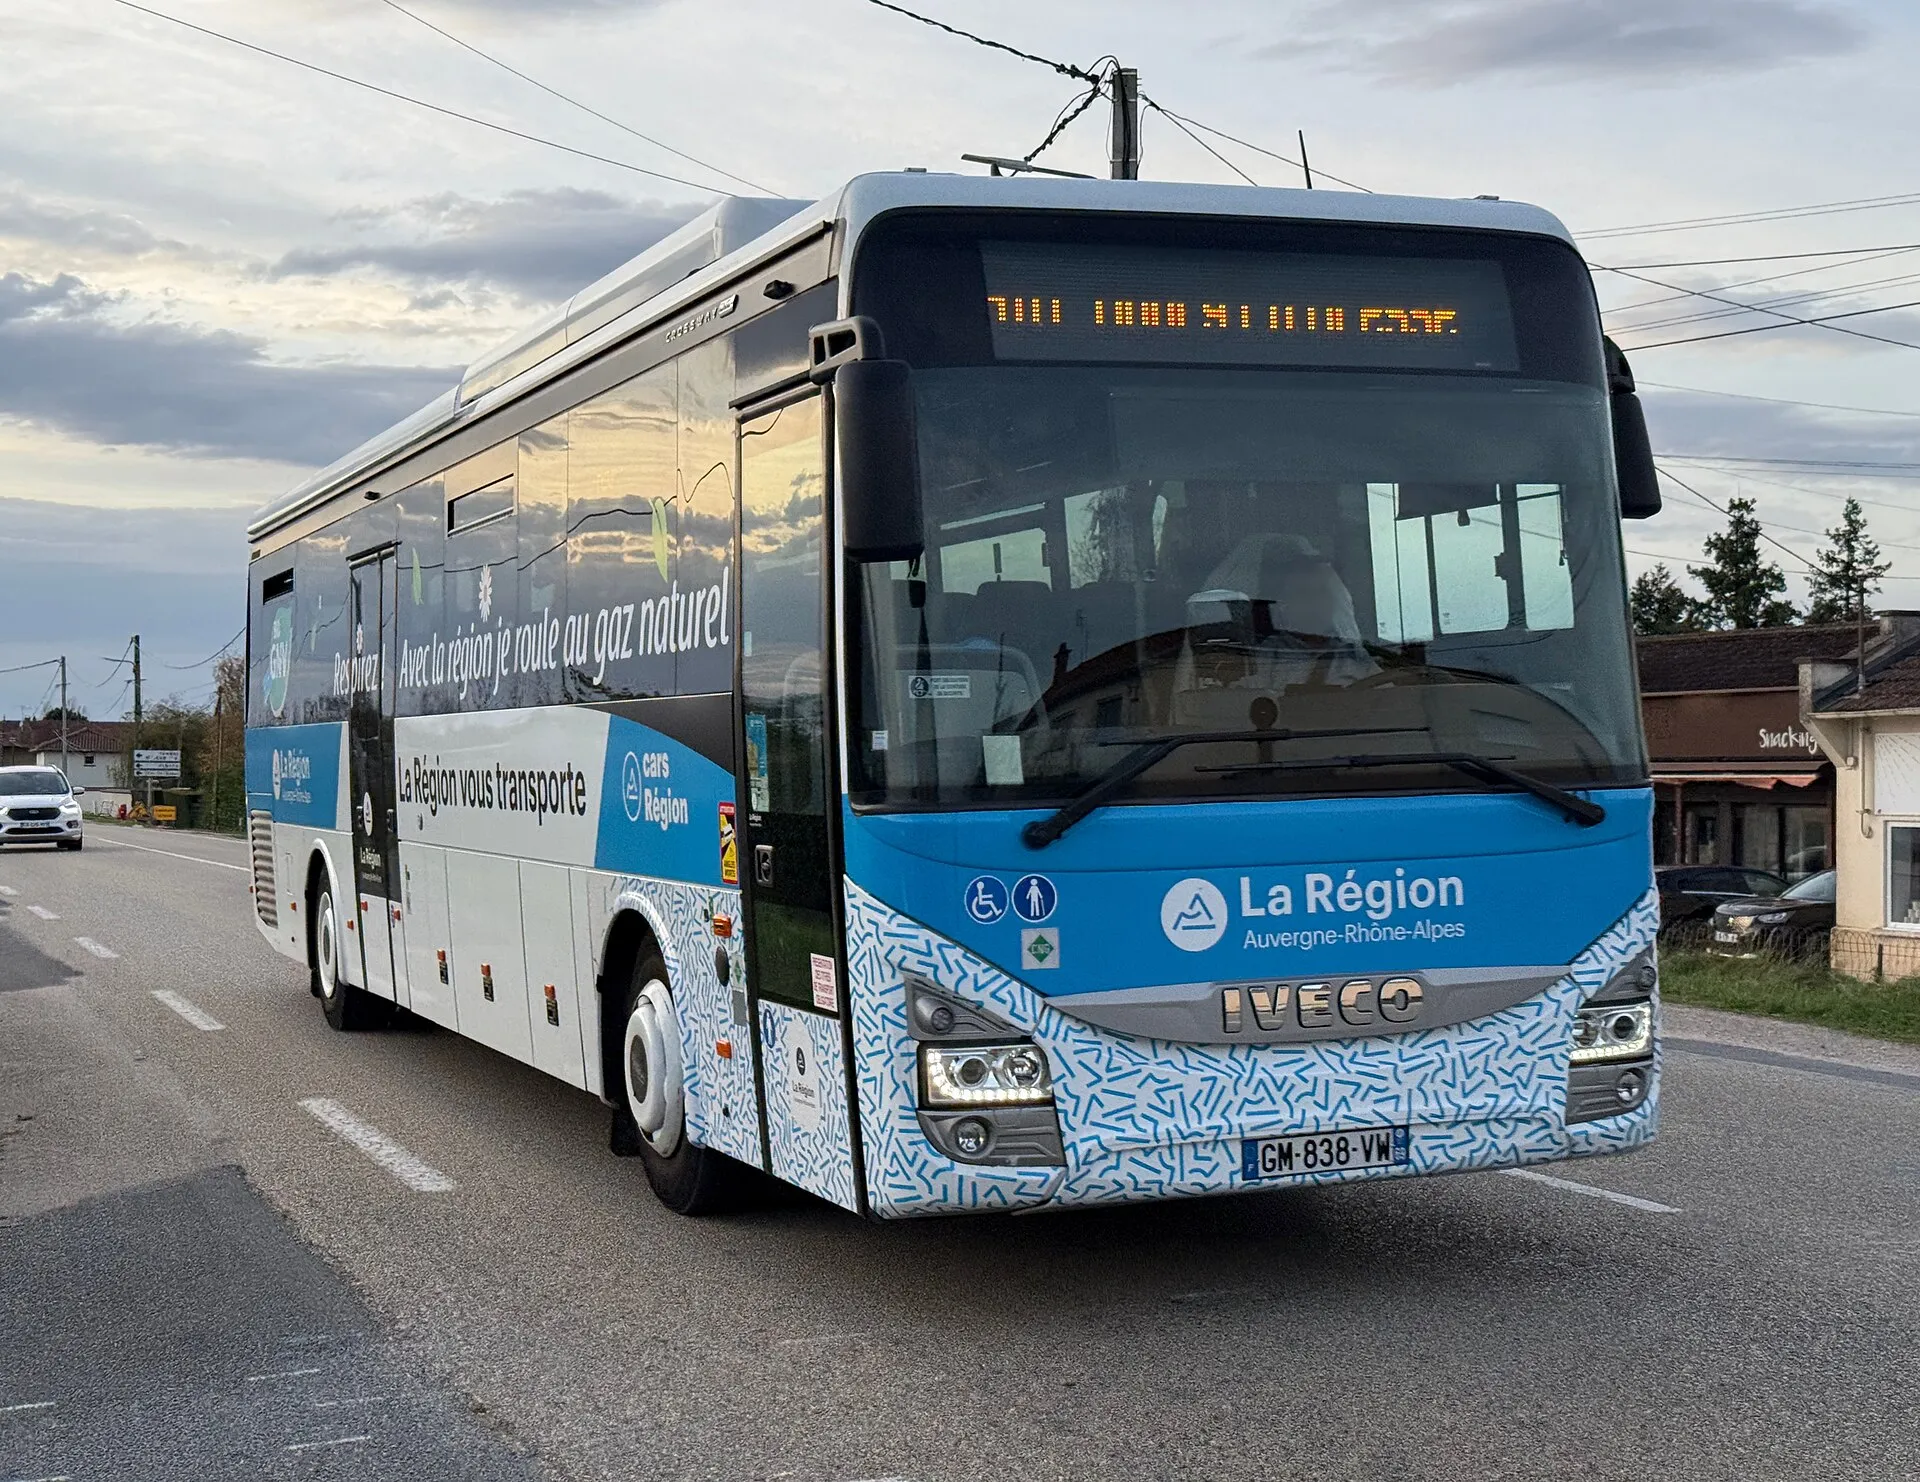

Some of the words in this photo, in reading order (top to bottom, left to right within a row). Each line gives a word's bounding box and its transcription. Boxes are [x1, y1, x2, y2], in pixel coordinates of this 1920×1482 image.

[665, 307, 718, 343] CROSSWAY
[399, 639, 431, 689] Avec
[432, 632, 445, 685] la
[447, 622, 494, 700] région
[493, 616, 511, 696] je
[514, 607, 559, 674] roule
[563, 612, 590, 668] au
[593, 604, 635, 686] gaz
[639, 565, 730, 656] naturel
[333, 652, 379, 708] Respirez
[1759, 725, 1818, 755] Snacking
[642, 751, 670, 779] cars
[399, 757, 412, 804] La
[414, 755, 457, 817] Région
[460, 768, 494, 809] vous
[496, 762, 587, 826] transporte
[643, 786, 689, 831] Région
[1240, 876, 1292, 918] La
[1305, 868, 1465, 921] Région
[1243, 919, 1466, 951] Auvergne-Rhône-Alpes
[1221, 976, 1424, 1034] IVECO
[1261, 1132, 1391, 1174] GM-838-VW
